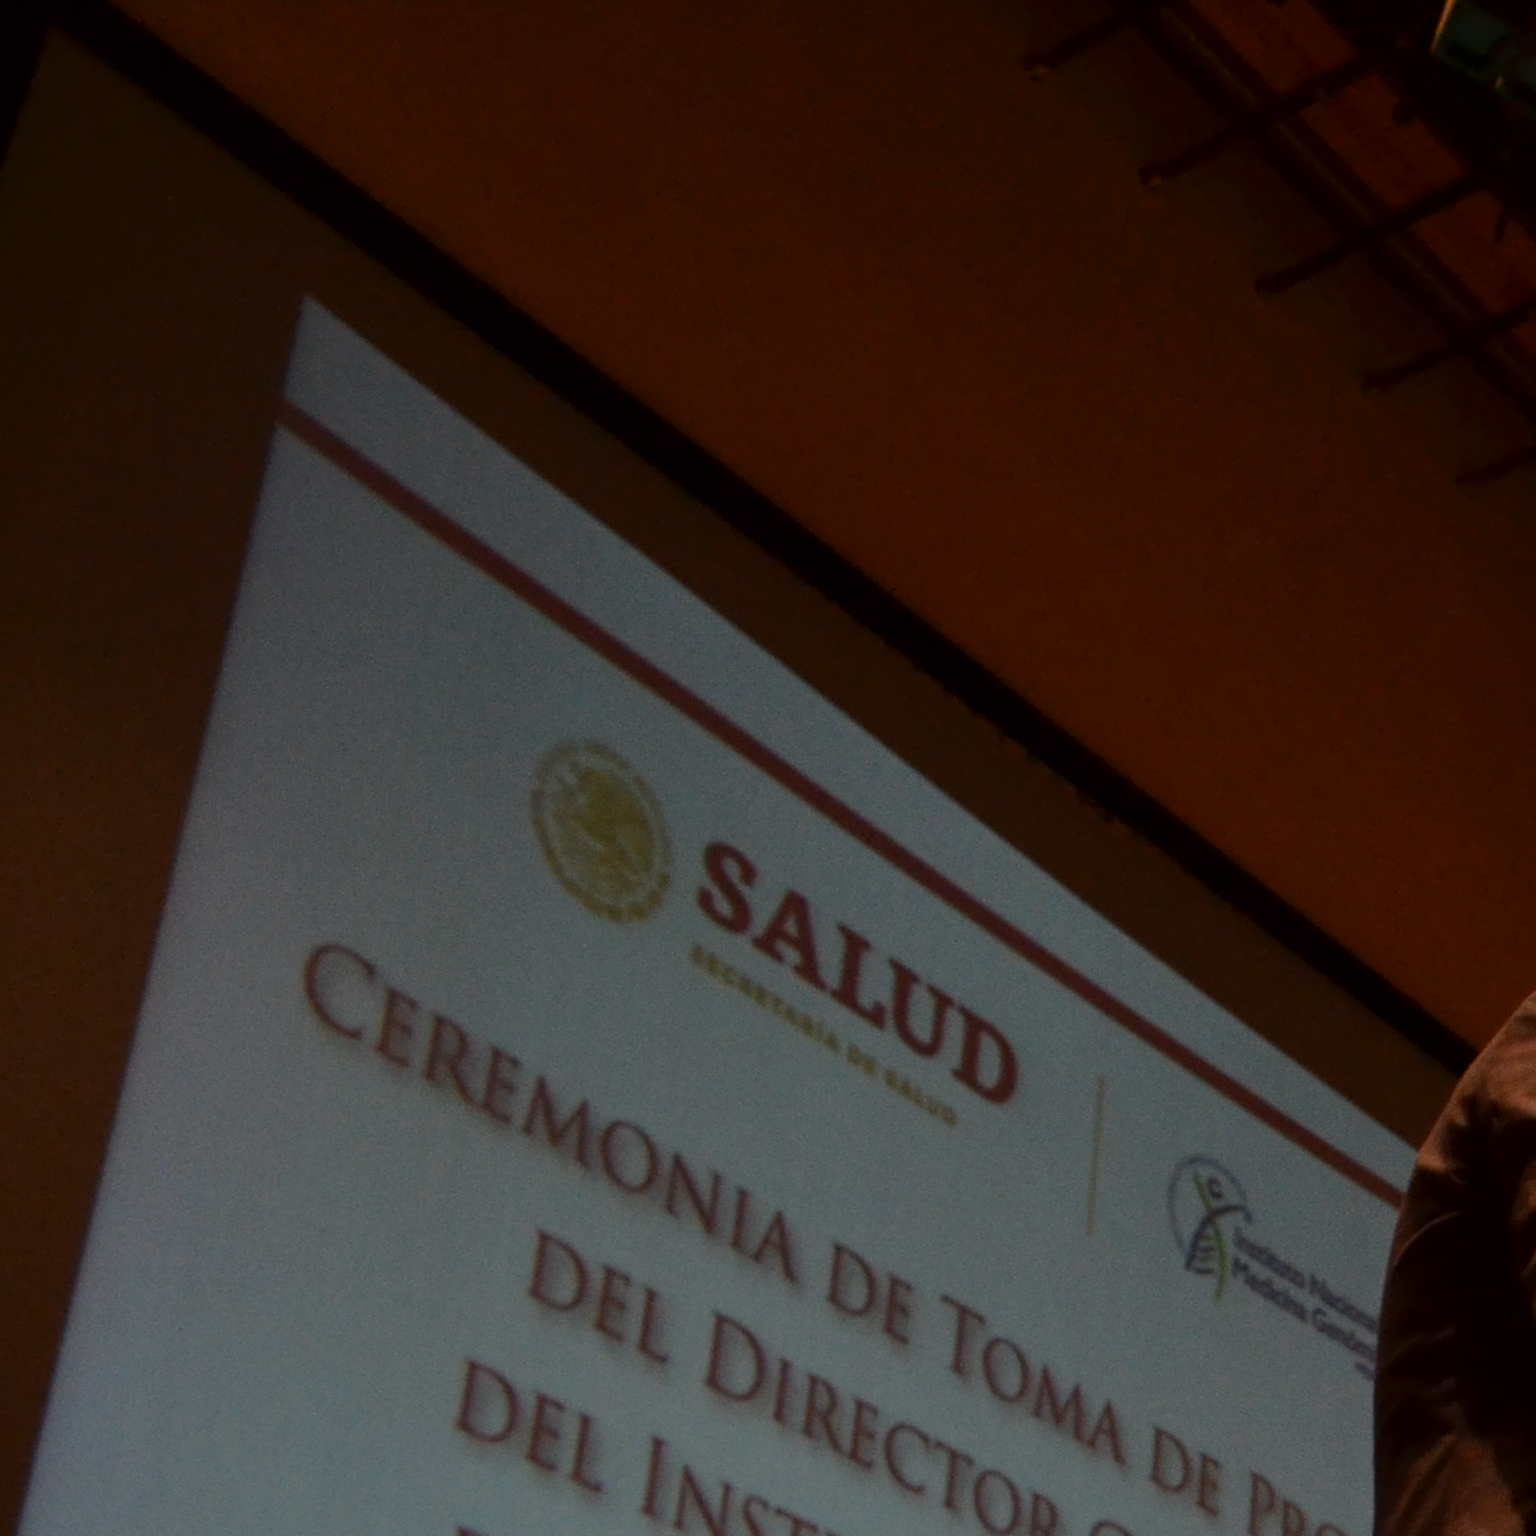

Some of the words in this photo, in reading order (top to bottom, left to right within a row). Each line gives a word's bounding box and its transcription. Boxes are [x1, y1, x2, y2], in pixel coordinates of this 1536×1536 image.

[696, 841, 1018, 1104] SALUD
[303, 943, 800, 1284] CEREMONIA
[827, 1241, 914, 1345] DE
[941, 1294, 1128, 1469] TOMA
[1149, 1427, 1222, 1517] DE
[528, 1229, 669, 1365] DEL
[455, 1358, 604, 1494] DEL
